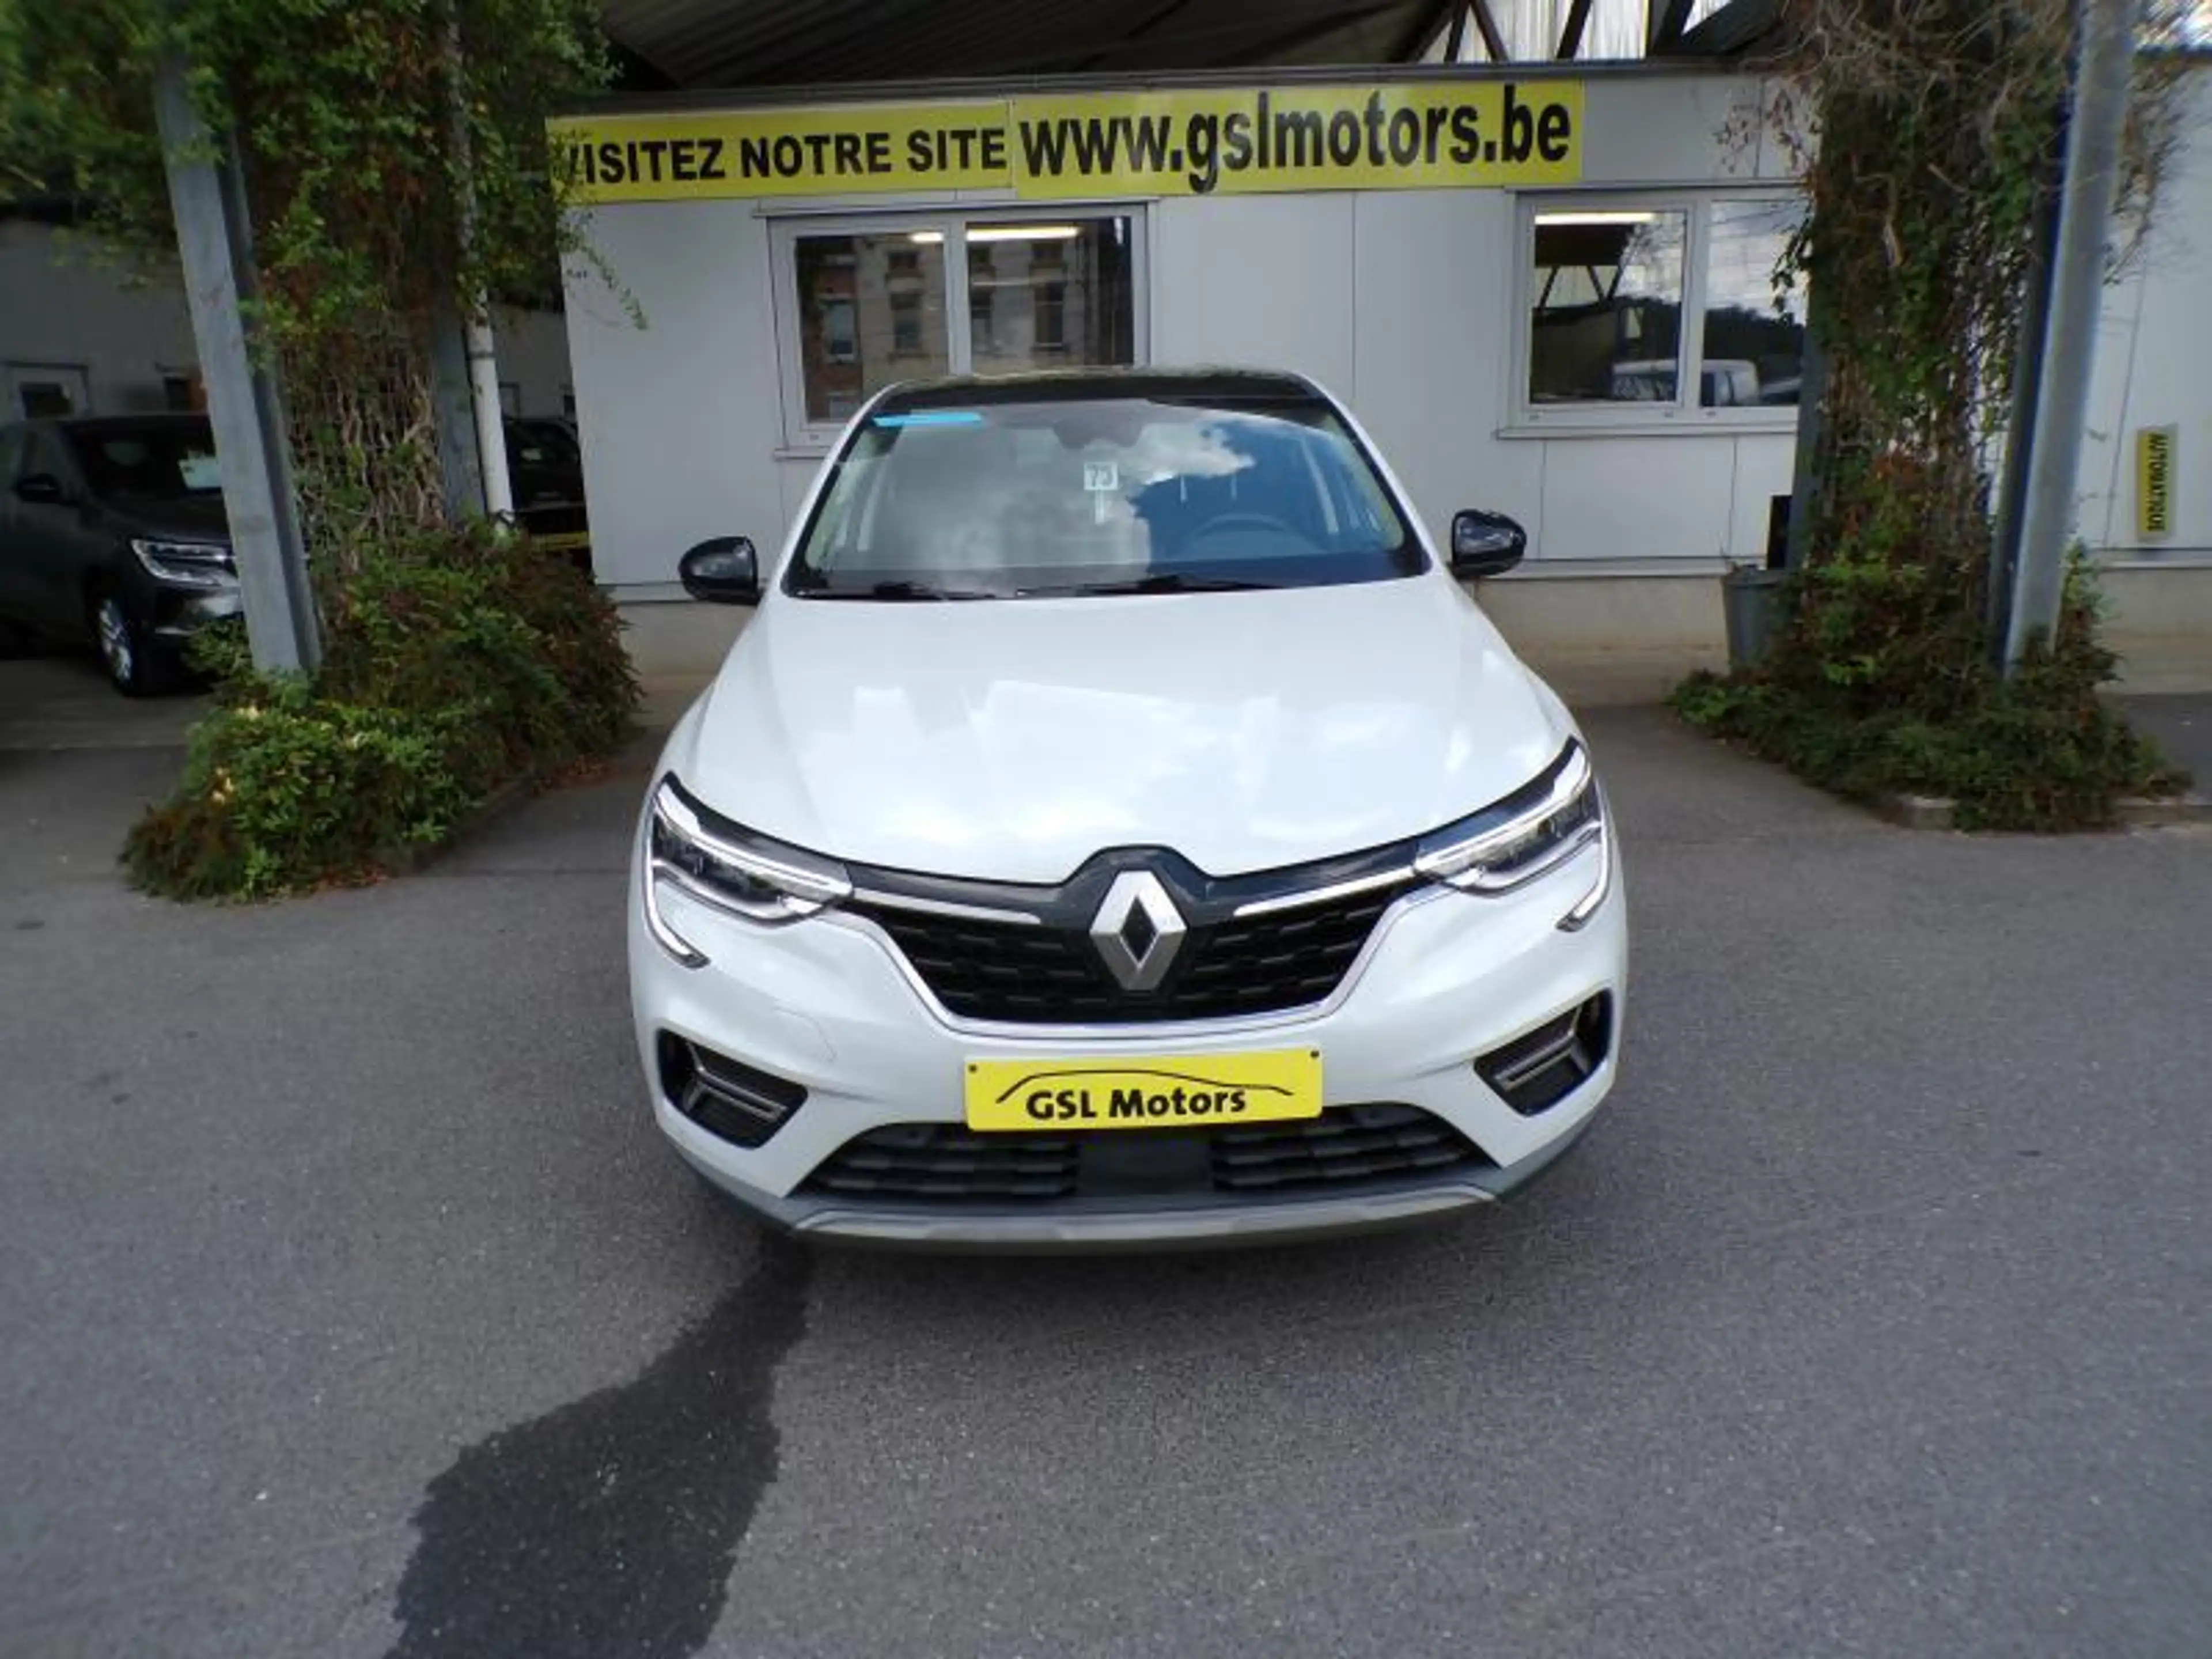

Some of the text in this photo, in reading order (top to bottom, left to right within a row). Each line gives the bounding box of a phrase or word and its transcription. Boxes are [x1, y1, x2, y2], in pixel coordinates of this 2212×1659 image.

[741, 133, 892, 177] NOTRE
[907, 128, 1006, 171] SITE
[1019, 84, 1570, 192] www.gslmotors.be
[1026, 1088, 1246, 1120] GSL Motors
